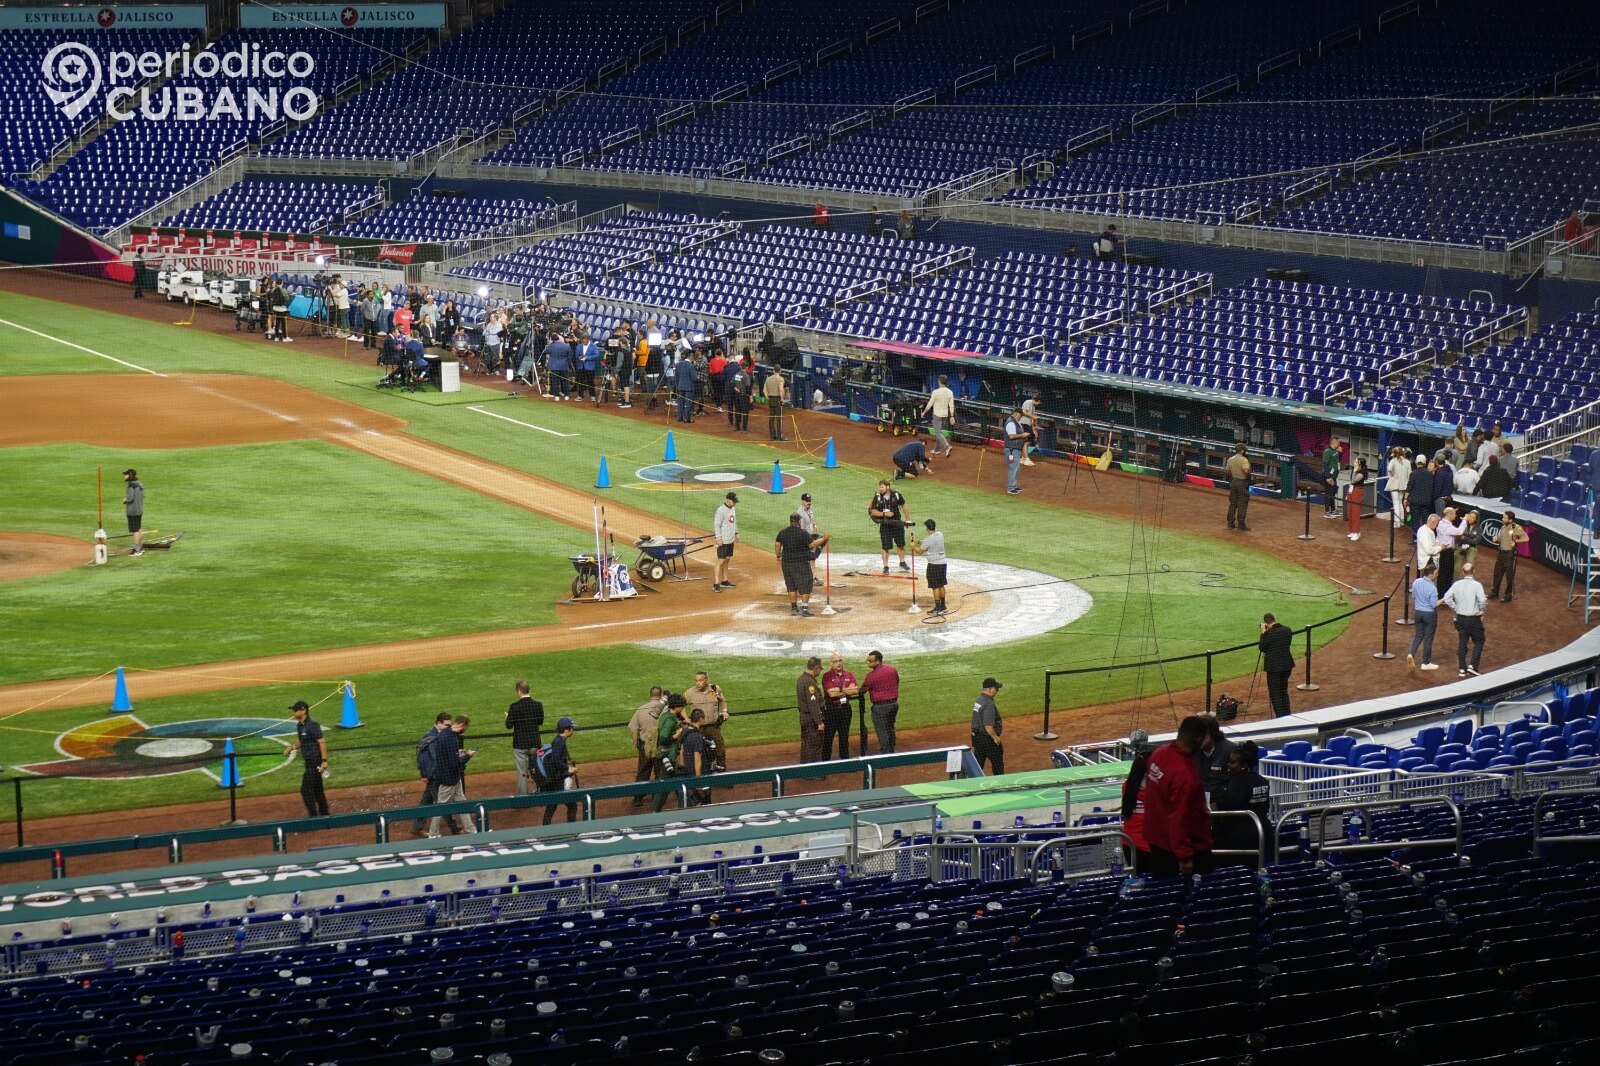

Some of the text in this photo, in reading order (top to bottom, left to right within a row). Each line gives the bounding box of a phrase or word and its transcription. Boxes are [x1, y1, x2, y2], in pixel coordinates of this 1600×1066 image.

[25, 12, 174, 23] ESTRELLA JALISCO
[272, 11, 415, 22] ESTRELLA JALISCO
[380, 246, 414, 257] Budweiser
[236, 260, 256, 276] FOR
[1483, 521, 1500, 537] Kon
[1545, 541, 1584, 574] KONAMI
[694, 633, 917, 652] WORLD
[222, 839, 569, 886] BASEBALL
[578, 806, 841, 844] CLASSIC
